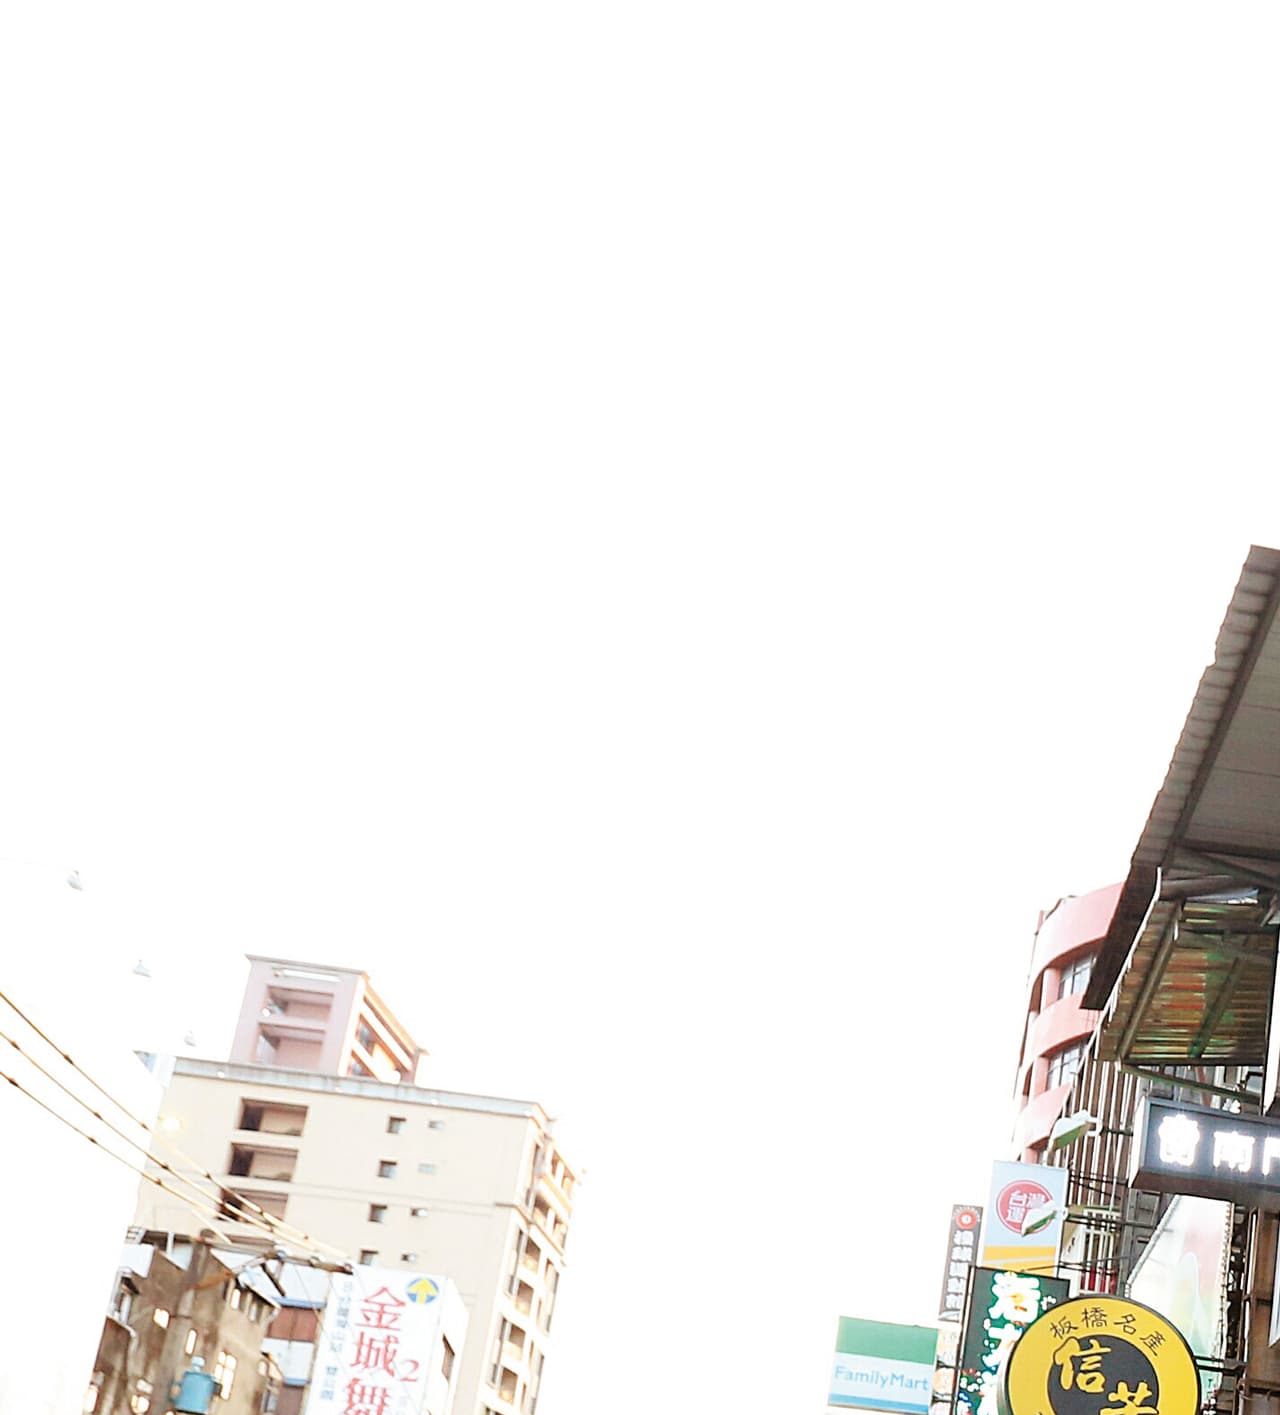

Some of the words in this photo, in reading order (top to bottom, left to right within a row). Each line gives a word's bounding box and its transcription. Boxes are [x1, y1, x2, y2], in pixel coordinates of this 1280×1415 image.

[1050, 1306, 1166, 1357] 板橋名產
[834, 1365, 929, 1392] FamilyMart
